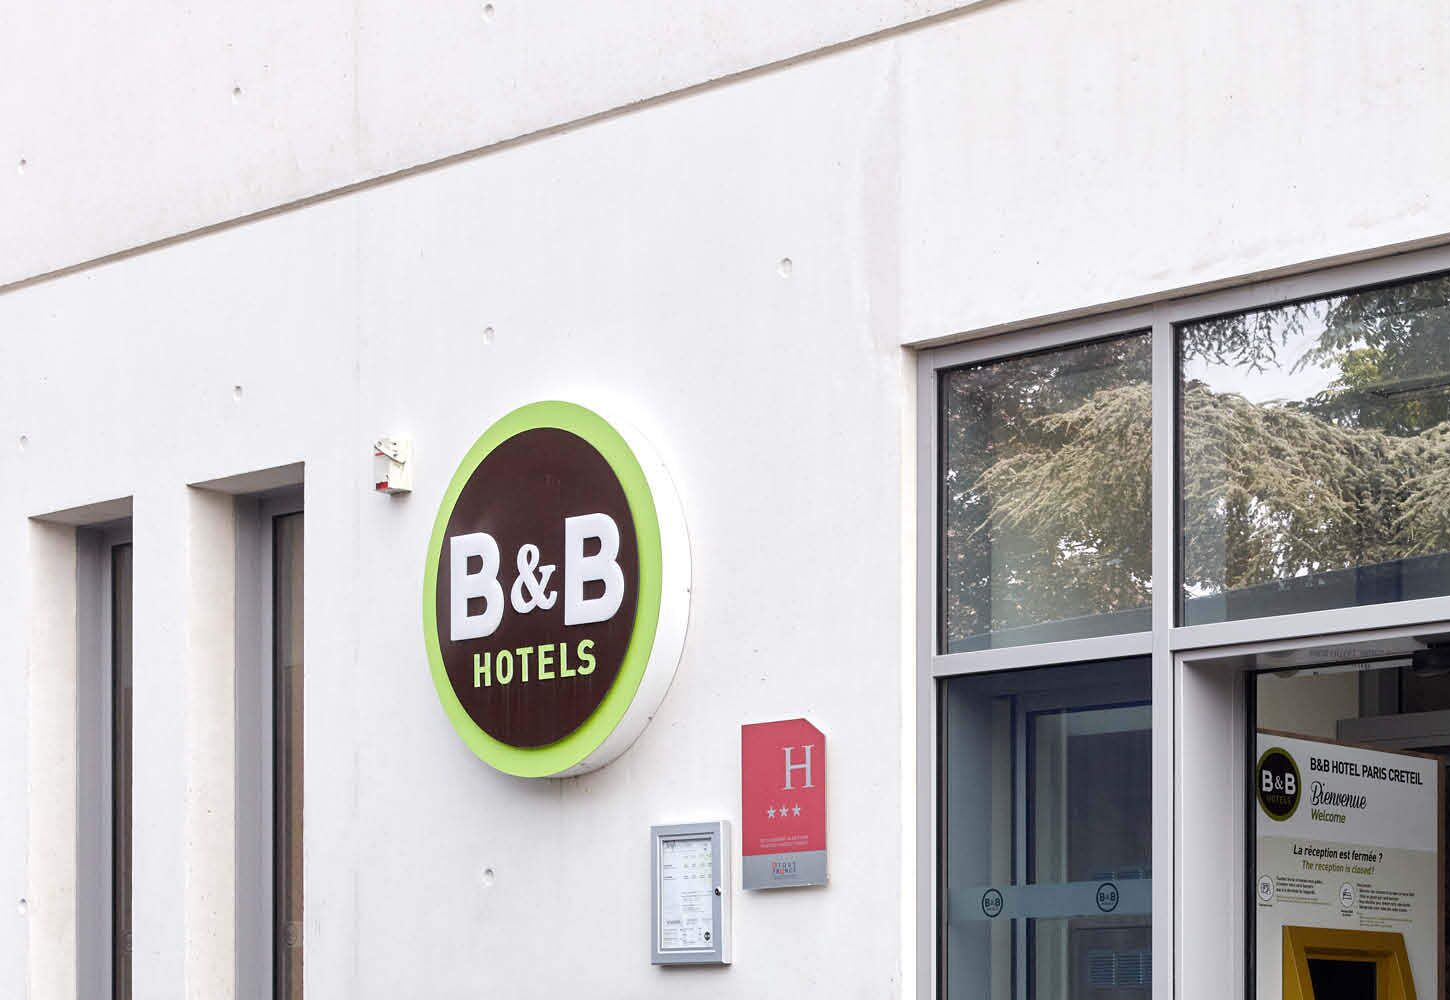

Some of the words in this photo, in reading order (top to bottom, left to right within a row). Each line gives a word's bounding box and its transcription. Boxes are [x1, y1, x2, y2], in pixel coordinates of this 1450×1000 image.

[450, 513, 625, 641] B&B
[473, 639, 597, 688] HOTELS
[781, 744, 816, 791] H
[1310, 757, 1330, 772] B&B
[1332, 760, 1361, 777] HOTEL
[1362, 765, 1387, 780] PARIS
[1388, 768, 1423, 785] CRETEIL
[1262, 769, 1296, 795] B&B
[1311, 780, 1367, 809] Bienvenue
[1311, 808, 1346, 824] Welcome
[1293, 844, 1303, 855] La
[1304, 845, 1337, 860] réception
[1339, 850, 1350, 860] est
[1351, 849, 1377, 862] fermée
[1378, 852, 1383, 863] ?
[1302, 860, 1313, 871] The
[1314, 862, 1345, 873] reception
